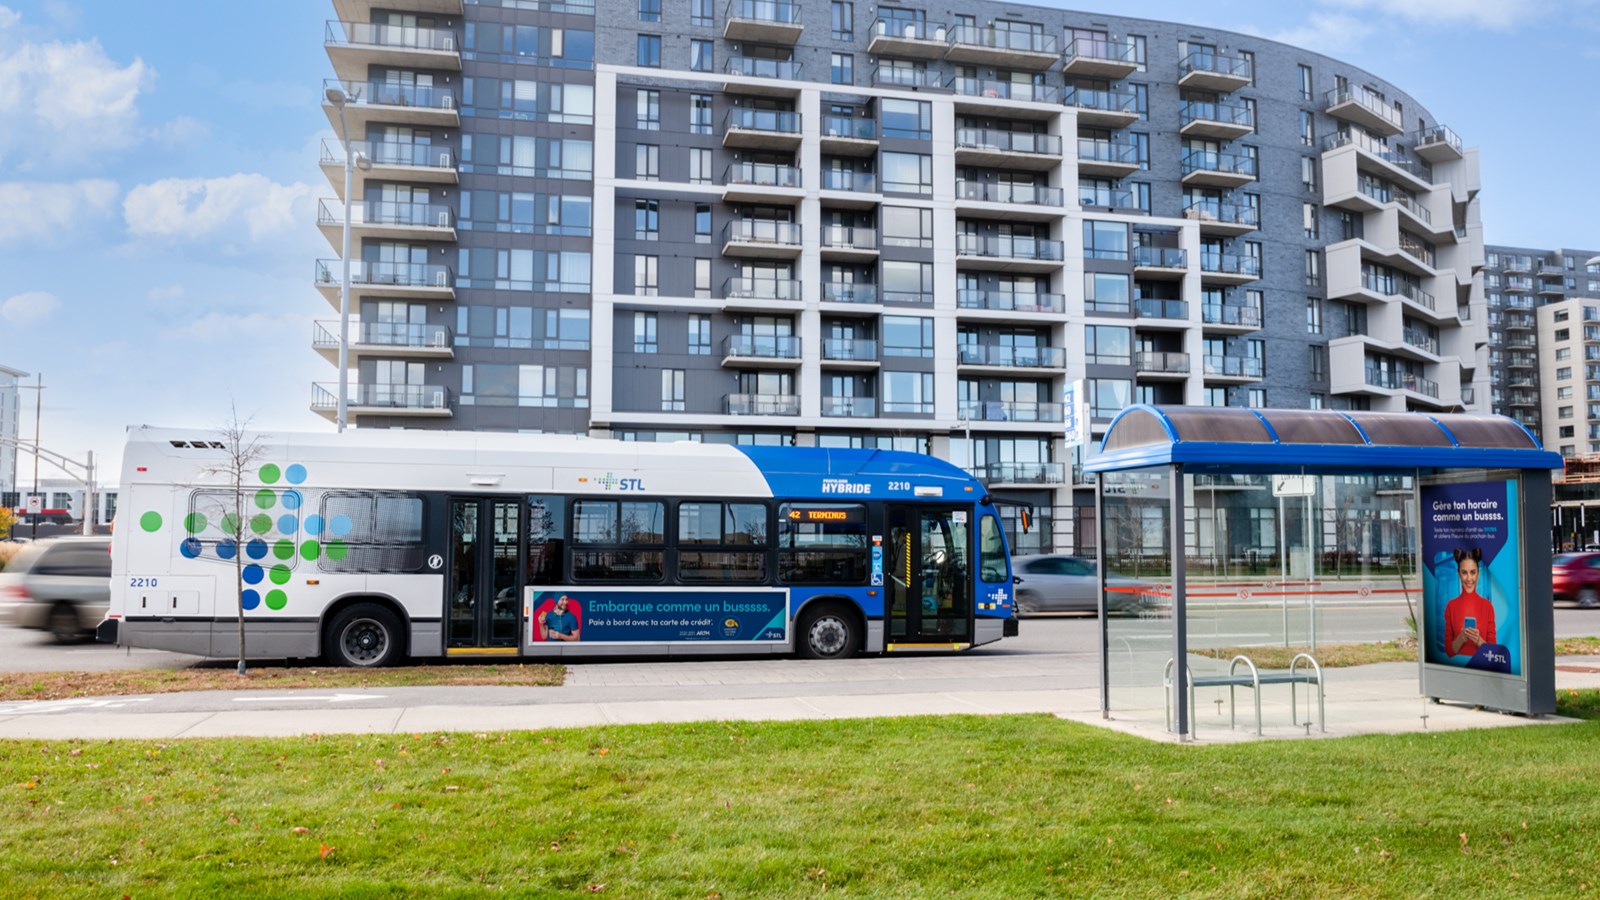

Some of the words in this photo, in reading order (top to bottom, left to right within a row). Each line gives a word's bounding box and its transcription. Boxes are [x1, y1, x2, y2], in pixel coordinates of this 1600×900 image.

[619, 479, 645, 491] STL
[822, 484, 871, 494] HYBRIDE
[888, 482, 910, 490] 2210
[1433, 501, 1452, 510] Gère
[1453, 501, 1466, 509] ton
[1467, 499, 1498, 509] horaire
[808, 511, 847, 519] TERMINUS
[130, 577, 158, 587] 2210
[589, 600, 653, 614] Embarque
[656, 603, 701, 612] comme
[705, 603, 720, 612] un
[723, 600, 771, 612] busssss.
[588, 618, 604, 626] Paie
[606, 618, 611, 626] à
[613, 618, 630, 626] bord
[680, 618, 689, 626] de
[1494, 654, 1507, 664] STL
